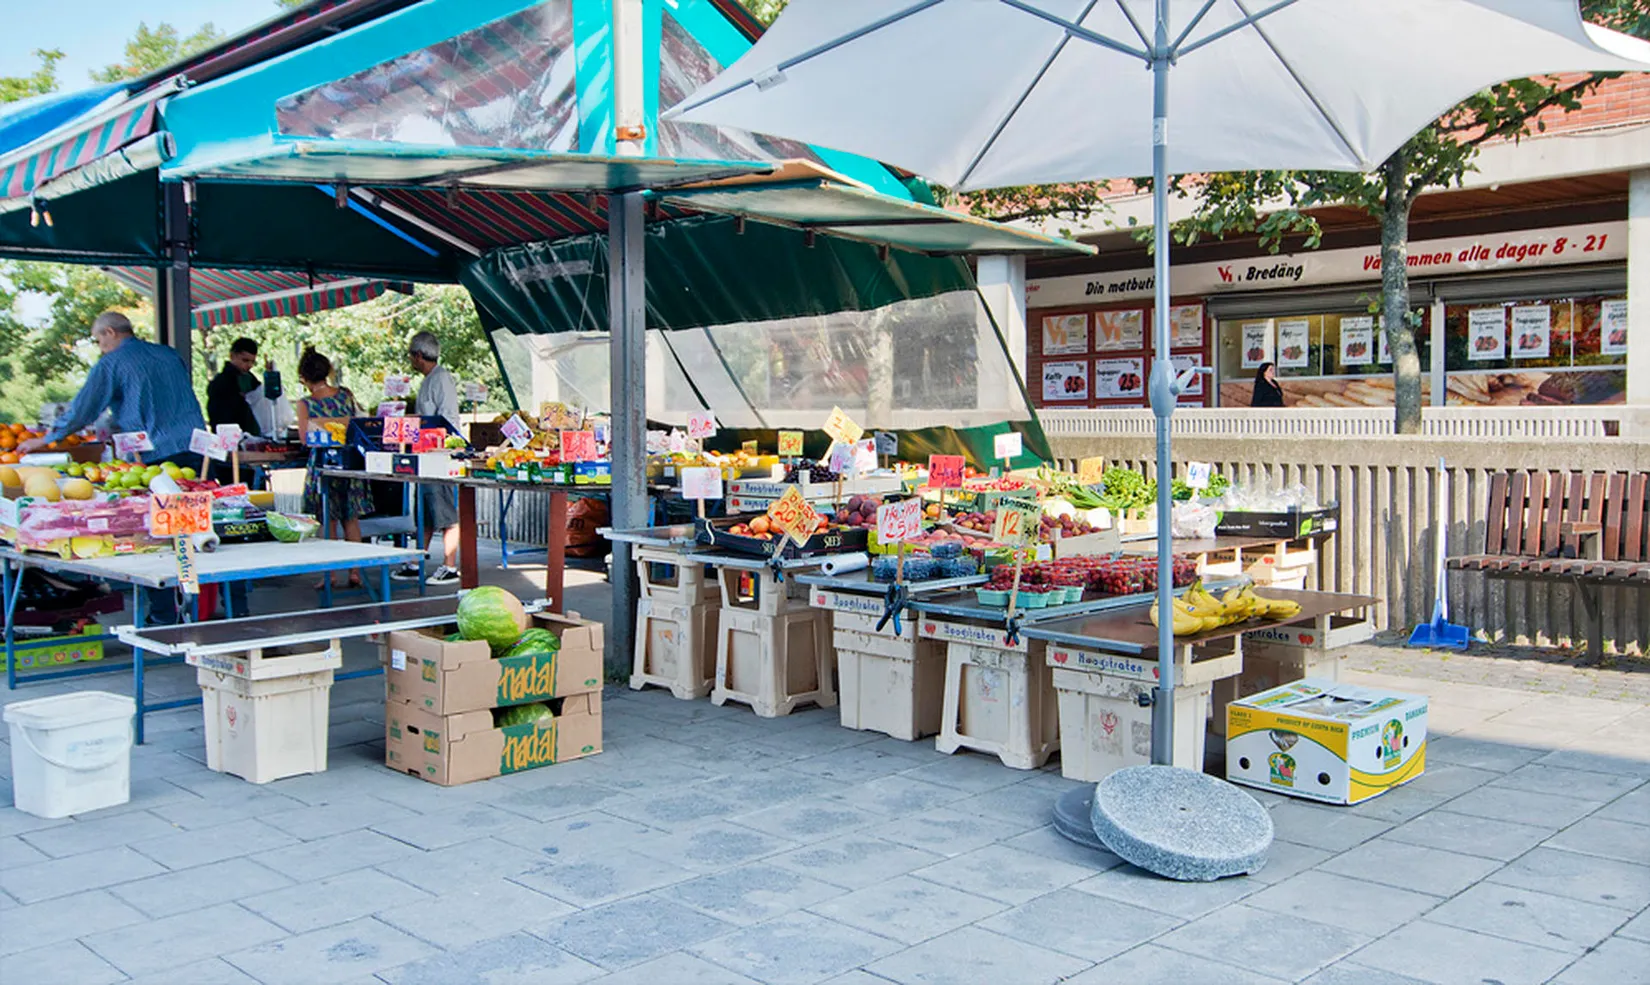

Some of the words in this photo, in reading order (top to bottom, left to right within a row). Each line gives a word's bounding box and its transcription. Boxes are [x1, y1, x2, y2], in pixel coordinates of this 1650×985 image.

[1363, 252, 1452, 271] Vämmen
[1458, 245, 1490, 263] alla
[1495, 241, 1548, 263] dagar
[1553, 237, 1568, 255] 8
[1583, 234, 1608, 253] 21
[1085, 281, 1105, 296] Din
[1108, 275, 1156, 293] matbuti
[1246, 263, 1303, 281] Bredäng
[1001, 511, 1020, 538] 12
[498, 654, 556, 701] nadal
[502, 720, 556, 770] nadal
